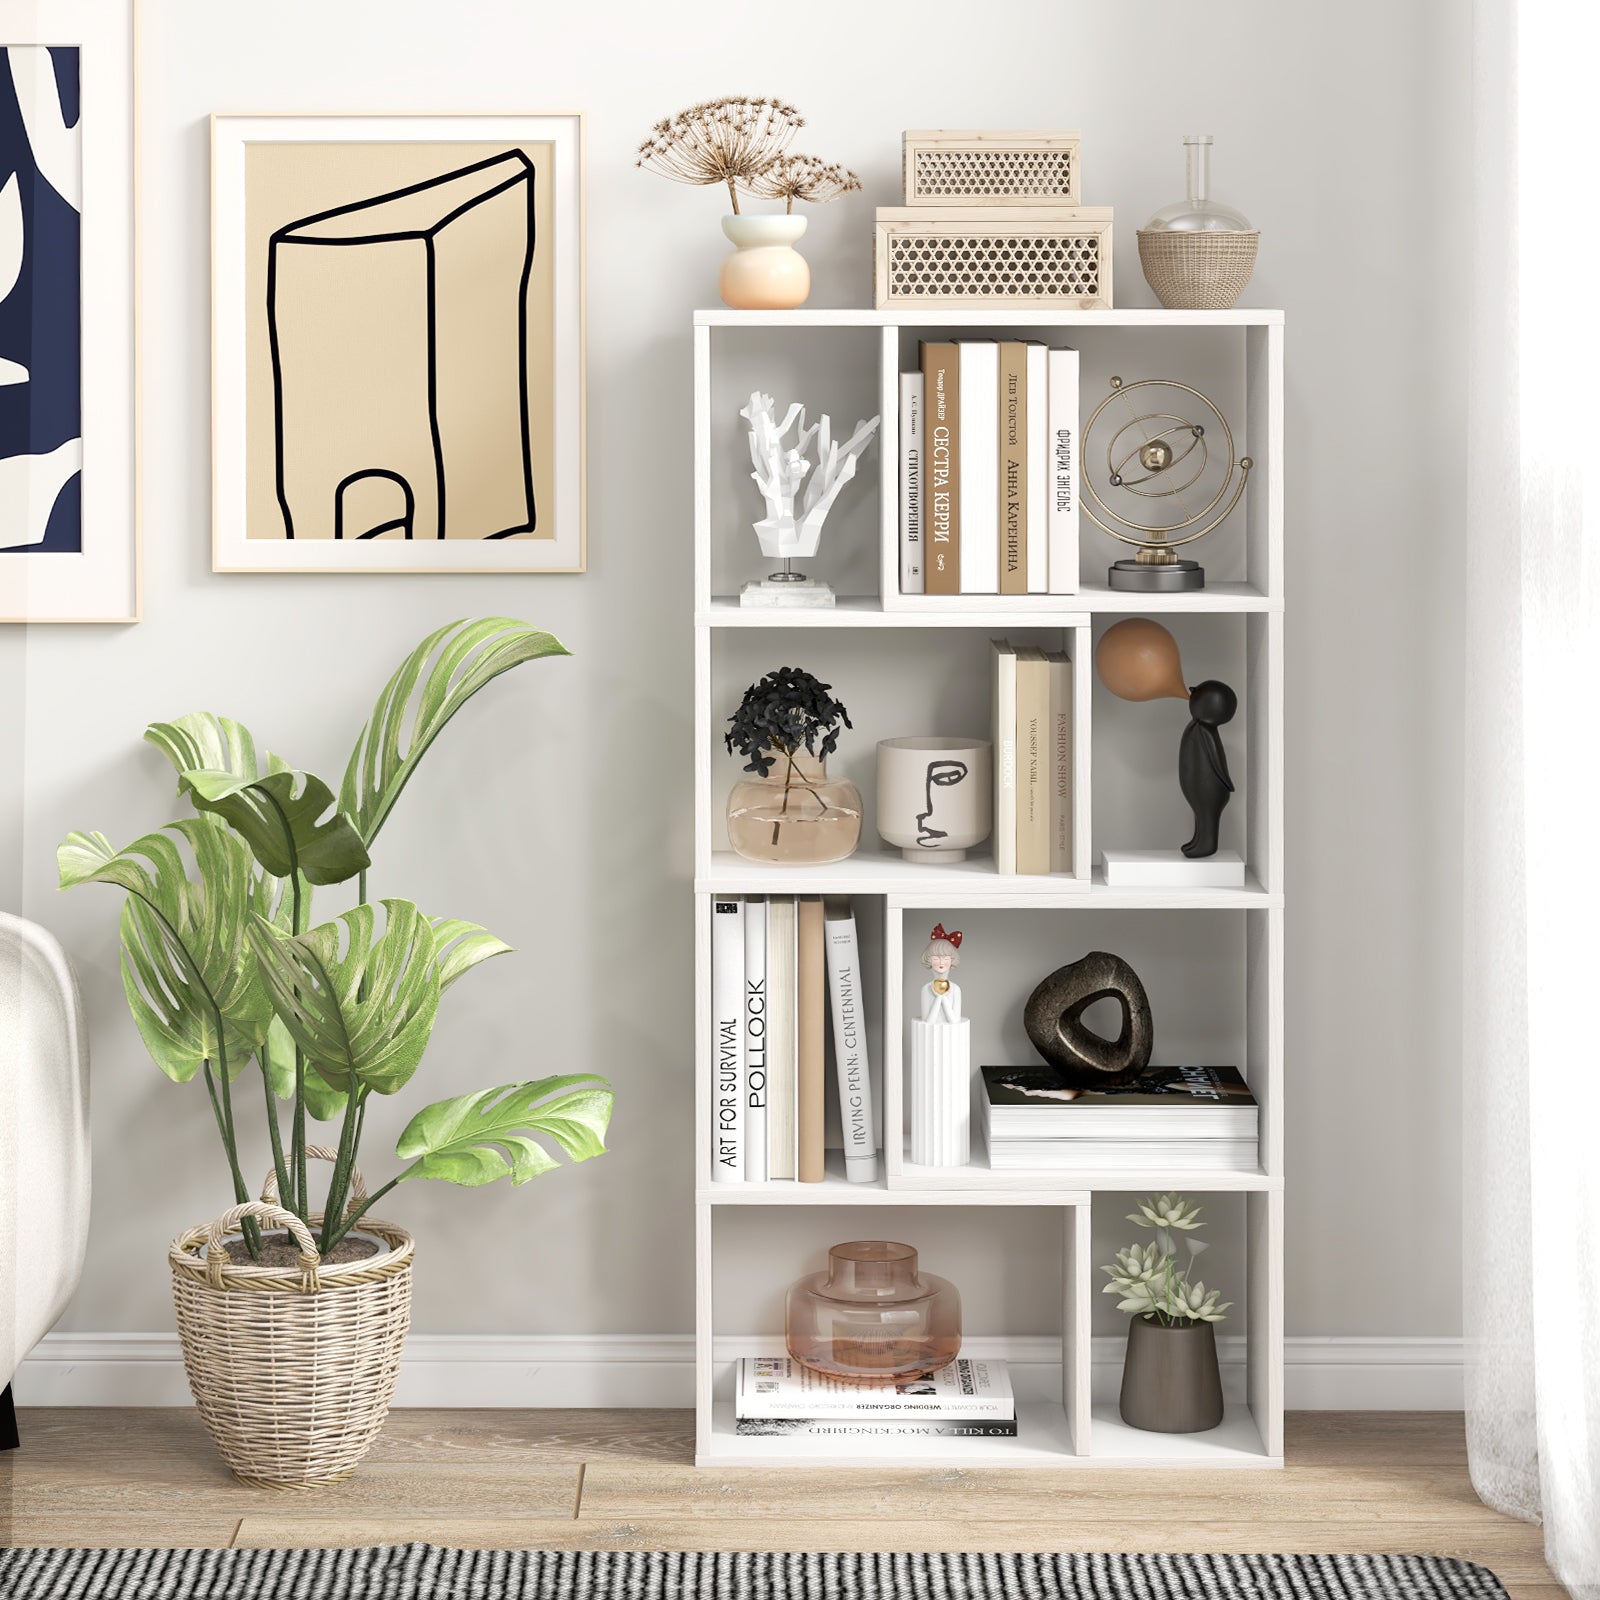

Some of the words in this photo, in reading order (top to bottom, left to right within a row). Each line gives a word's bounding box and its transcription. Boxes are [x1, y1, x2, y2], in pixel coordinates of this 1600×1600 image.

[936, 368, 946, 391] Теодор
[936, 392, 946, 421] ДРАЙЗЕР
[933, 426, 950, 488] СЕСТРА
[1056, 429, 1071, 471] ФРИДРИХ
[908, 449, 919, 542] СТИХОТВОРЕНИЯ
[1056, 475, 1071, 512] ЭНГЕЛЬС
[933, 492, 950, 543] КЕРРИ
[1029, 718, 1038, 757] YOUSSEF
[1056, 713, 1067, 763] FASHION
[1029, 759, 1038, 786] NABIL
[1056, 765, 1067, 799] SHOW
[839, 966, 857, 1048] CENTENNIAL
[719, 1018, 737, 1093] SURVIVAL
[747, 979, 765, 1108] POLLOCK
[847, 1053, 860, 1091] PENN:
[719, 1098, 737, 1131] FOR
[849, 1095, 866, 1145] IRVING
[719, 1138, 737, 1168] ART
[935, 1427, 945, 1435] A
[954, 1427, 984, 1435] KILL
[989, 1427, 1014, 1435] TO
